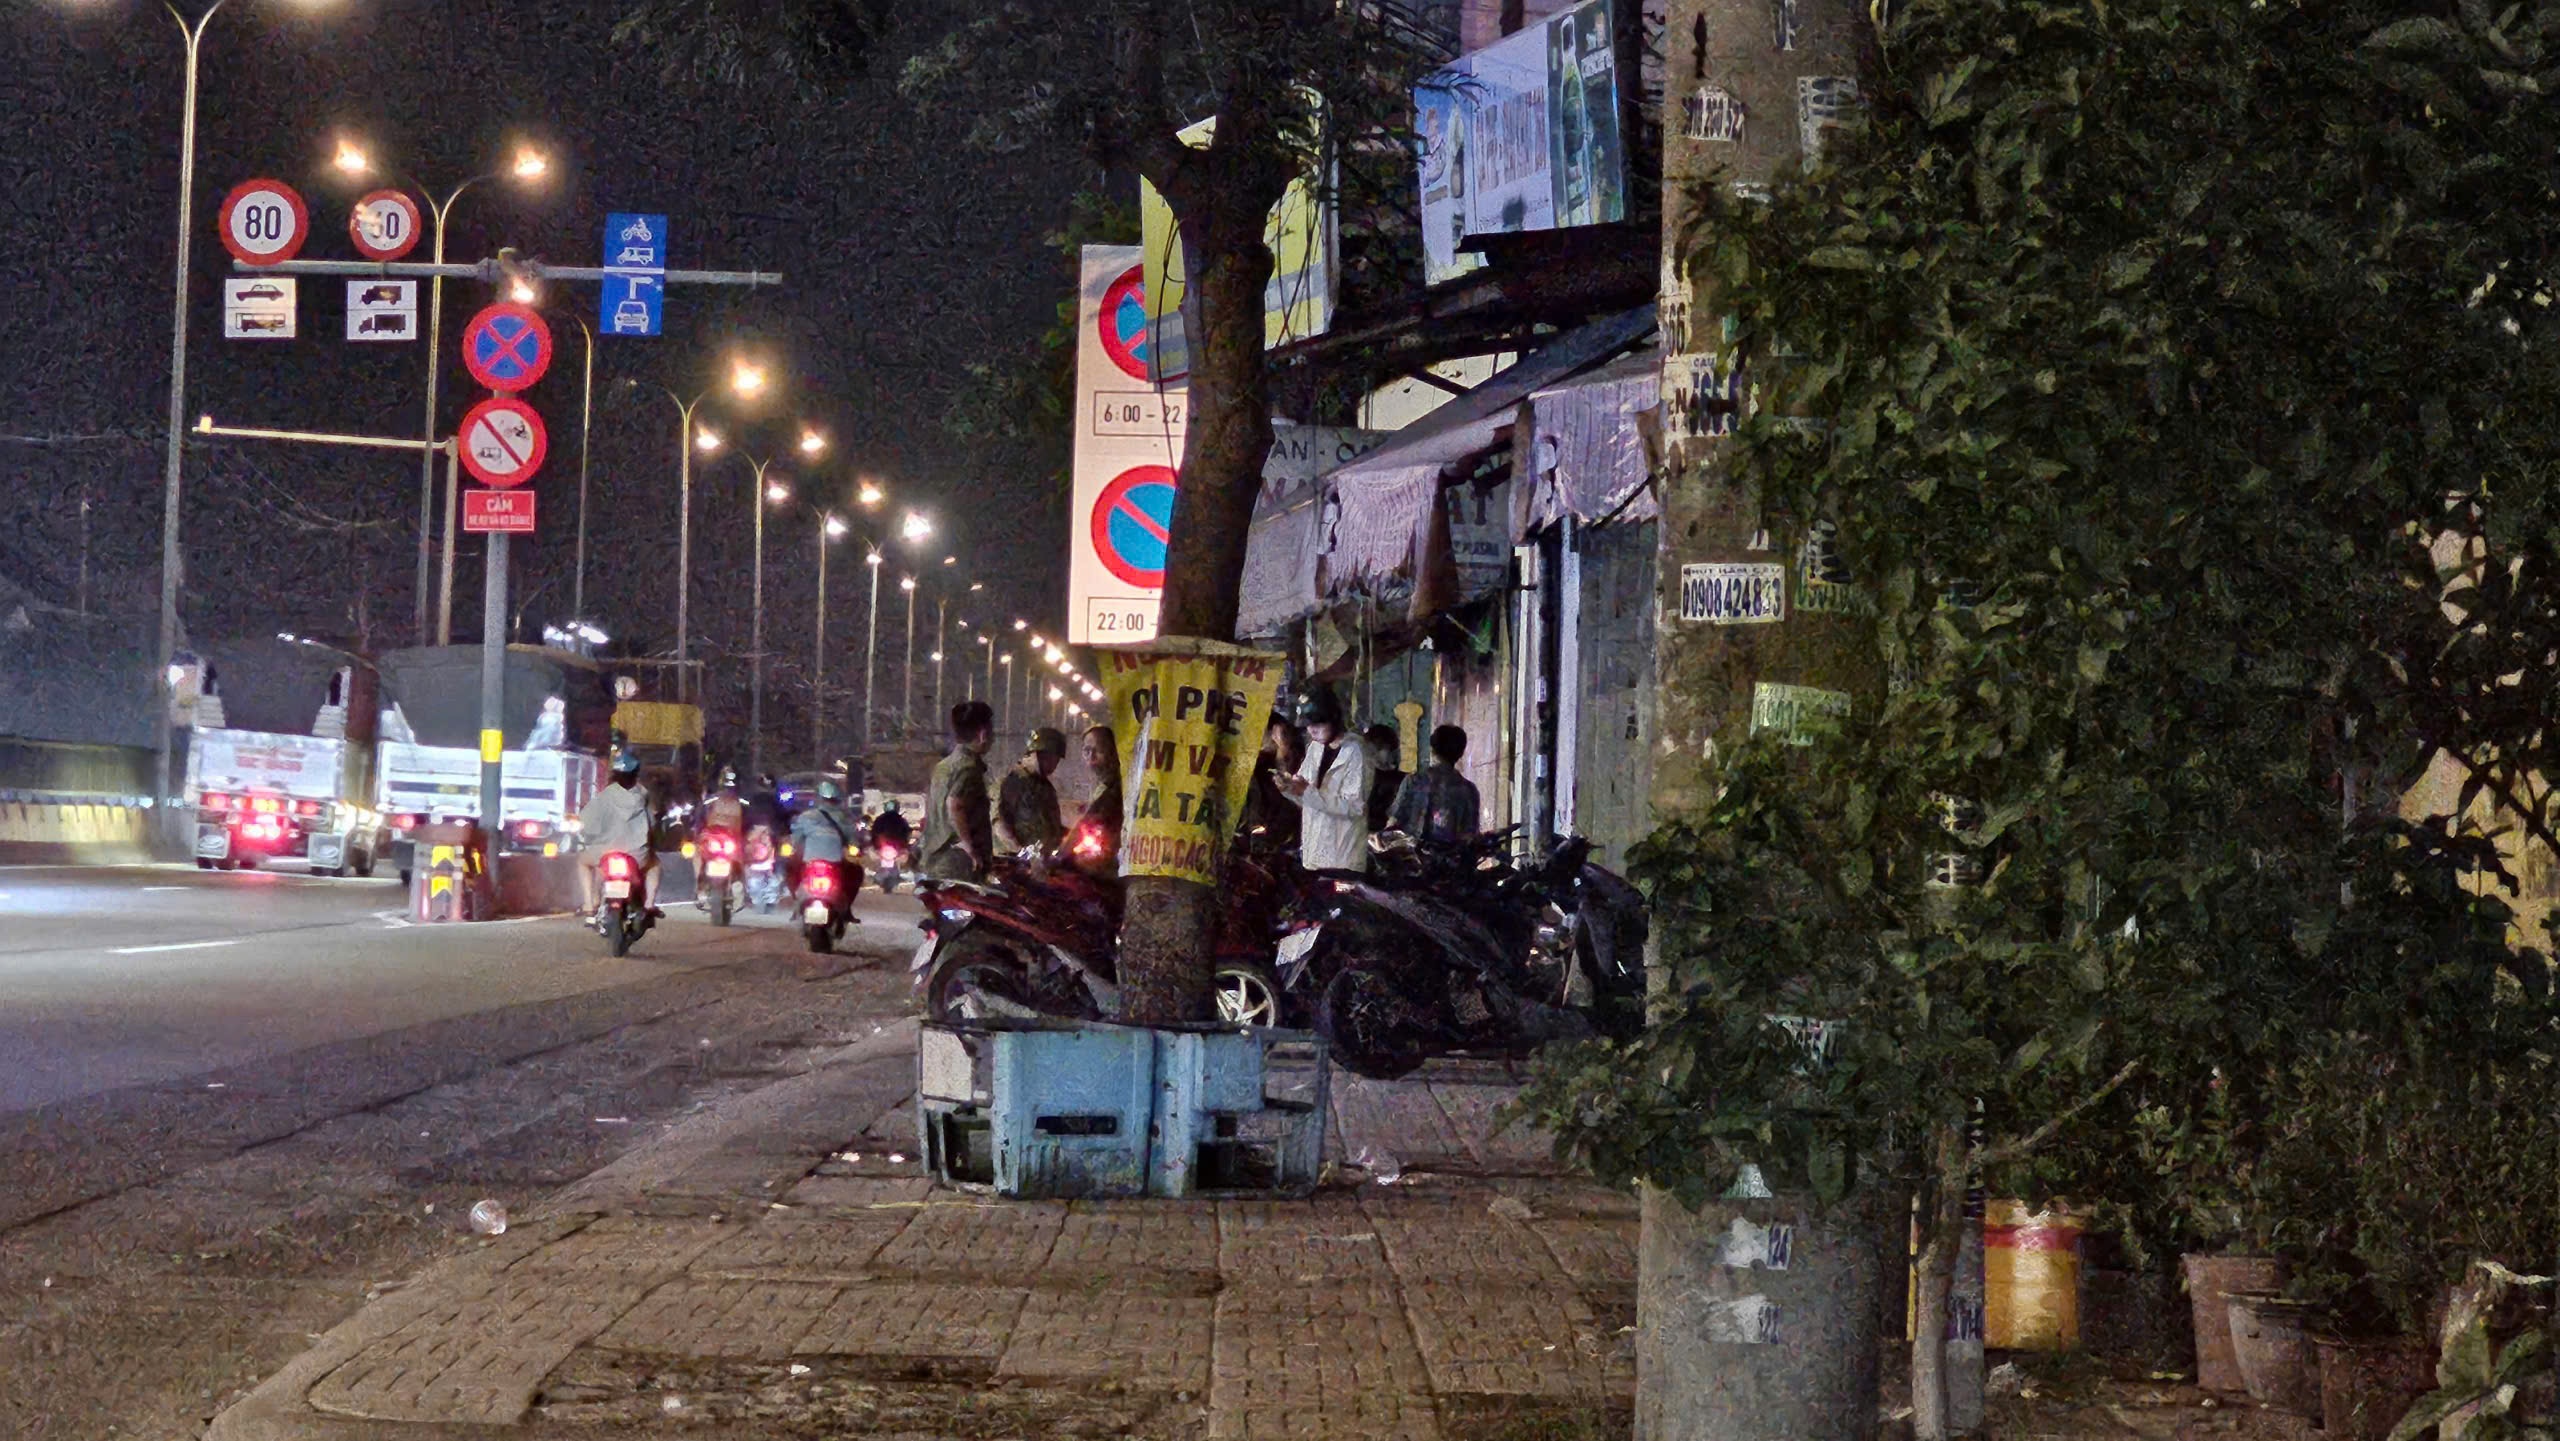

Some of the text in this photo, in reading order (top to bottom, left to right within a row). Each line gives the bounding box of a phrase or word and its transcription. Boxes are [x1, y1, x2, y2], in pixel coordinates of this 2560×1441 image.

[245, 206, 281, 240] 80
[1103, 404, 1141, 424] 6:00
[1096, 612, 1144, 632] 22:00
